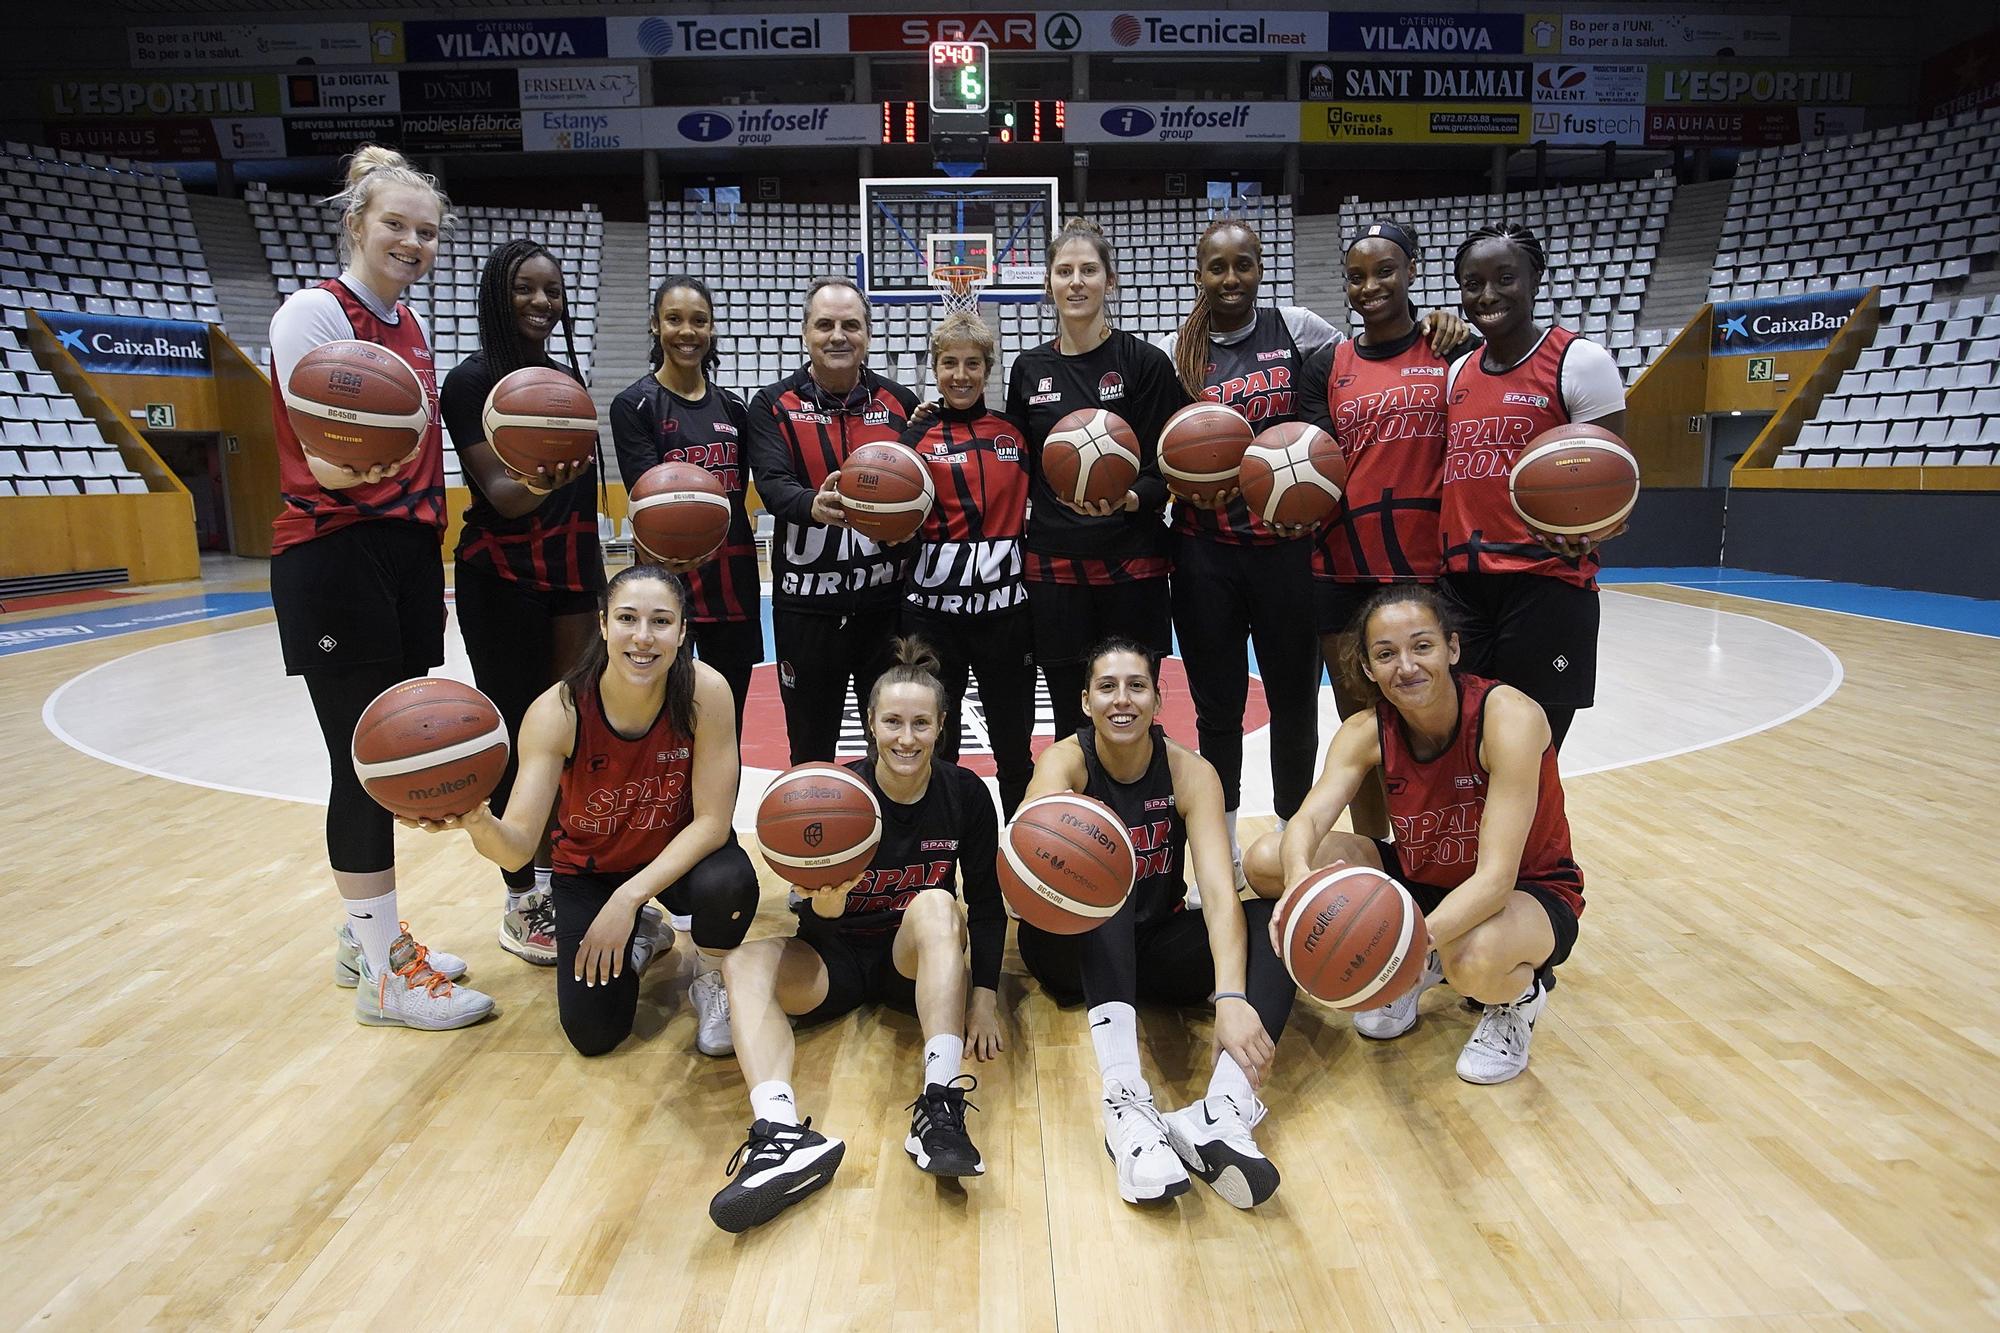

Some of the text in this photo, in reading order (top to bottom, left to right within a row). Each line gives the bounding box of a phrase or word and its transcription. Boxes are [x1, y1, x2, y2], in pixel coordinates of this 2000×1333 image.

[476, 22, 533, 33] CATERING
[1144, 17, 1306, 45] Tecnical meat
[1399, 16, 1455, 26] CATERING
[1569, 20, 1586, 32] Bo
[1589, 22, 1608, 35] per
[1612, 23, 1620, 32] a
[136, 32, 155, 43] Bo
[158, 33, 178, 46] per
[182, 34, 189, 43] a
[677, 19, 820, 51] Tecnical
[902, 20, 1033, 45] SPAR
[1360, 27, 1493, 51] VILANOVA
[436, 32, 576, 57] VILANOVA
[1568, 36, 1669, 50] Bo per a la salut.
[139, 47, 242, 61] Bo per a la salut.
[321, 74, 390, 87] La DIGITAL
[523, 78, 597, 93] FRISELVA
[960, 65, 981, 100] 6
[1344, 69, 1526, 98] SANT DALMAI
[1664, 70, 1856, 104] L'ESPORTIU
[52, 80, 256, 115] L'ESPORTIU
[322, 91, 386, 116] impser
[1536, 90, 1585, 101] VALENT
[543, 111, 609, 134] Estanys
[737, 108, 829, 133] infoself
[1159, 105, 1250, 129] infoself
[1343, 111, 1382, 123] Grues
[1563, 114, 1641, 135] fustech
[1653, 116, 1743, 131] BAUHAUS
[59, 129, 158, 147] BAUHAUS
[737, 132, 773, 147] group
[1159, 129, 1193, 143] group
[1343, 123, 1393, 137] Viñolas
[573, 131, 620, 150] Blaus
[1753, 307, 1855, 335] CaixaBan
[92, 333, 205, 360] CaixaBank
[1101, 384, 1124, 397] UNI
[1503, 394, 1536, 405] SPAR
[328, 408, 358, 421] BG4500
[865, 411, 888, 420] UNI
[1336, 383, 1439, 431] SPAR
[998, 447, 1017, 456] UNI
[407, 773, 479, 802] molten
[585, 771, 686, 816] SPAR
[1060, 812, 1118, 855] molten
[922, 840, 953, 850] SPAR
[1036, 884, 1064, 905] BG4500
[1303, 894, 1350, 956] molten
